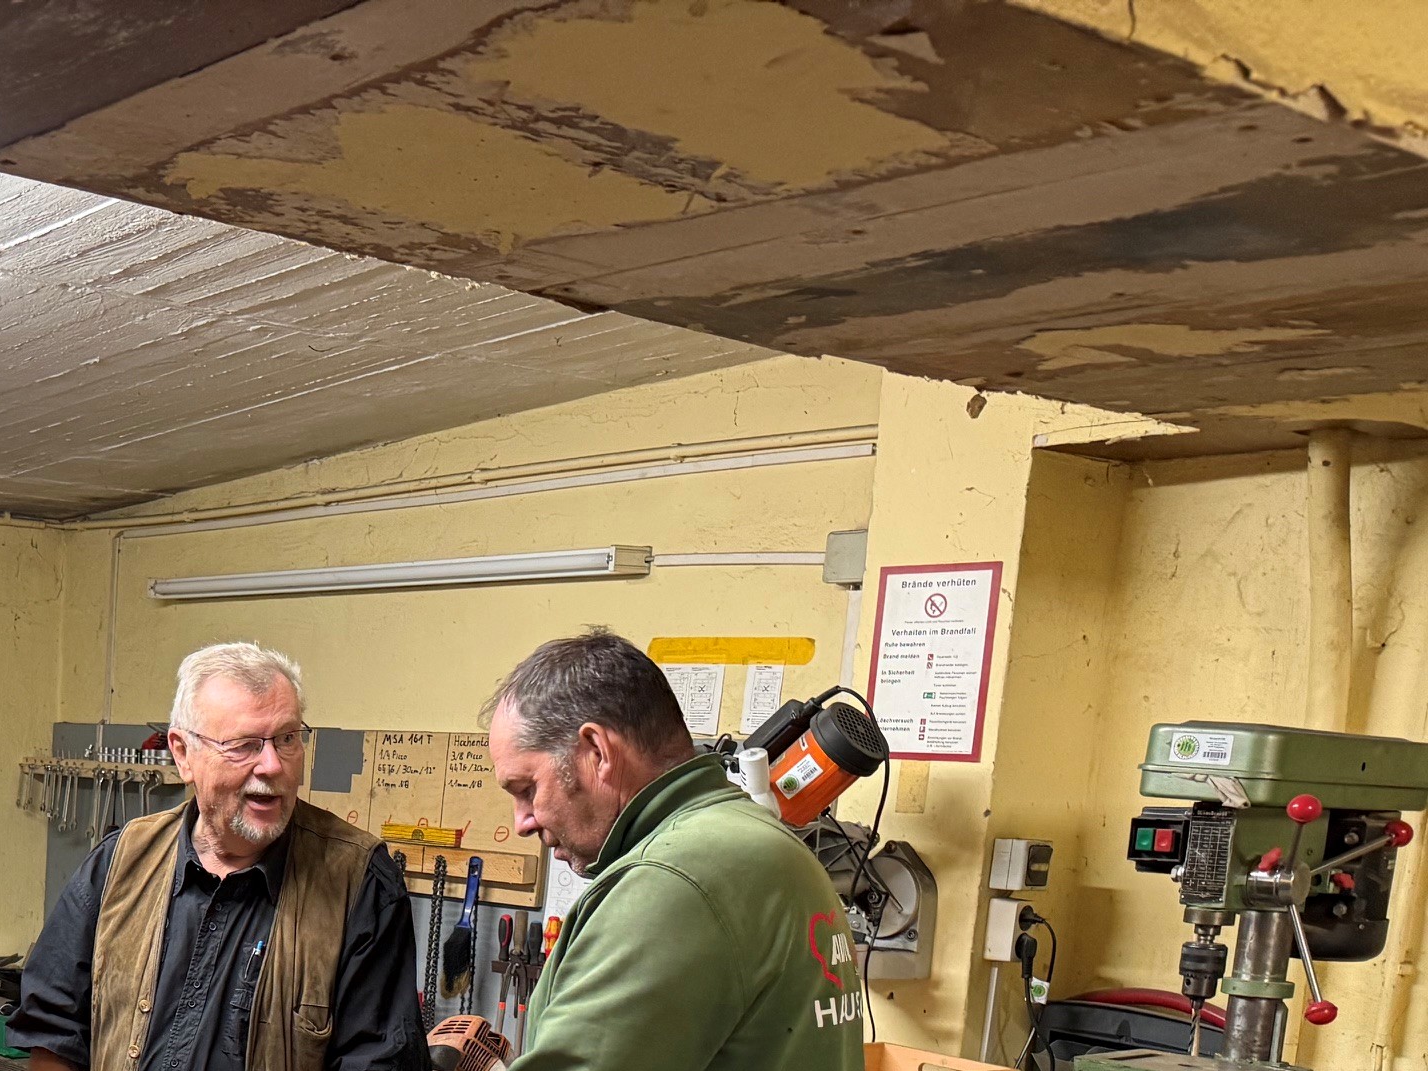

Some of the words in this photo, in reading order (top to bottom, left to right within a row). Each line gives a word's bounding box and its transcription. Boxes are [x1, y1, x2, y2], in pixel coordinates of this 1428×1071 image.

[901, 580, 933, 589] Brände
[937, 578, 977, 588] verhüten
[382, 733, 404, 745] MSA
[408, 734, 424, 745] 161
